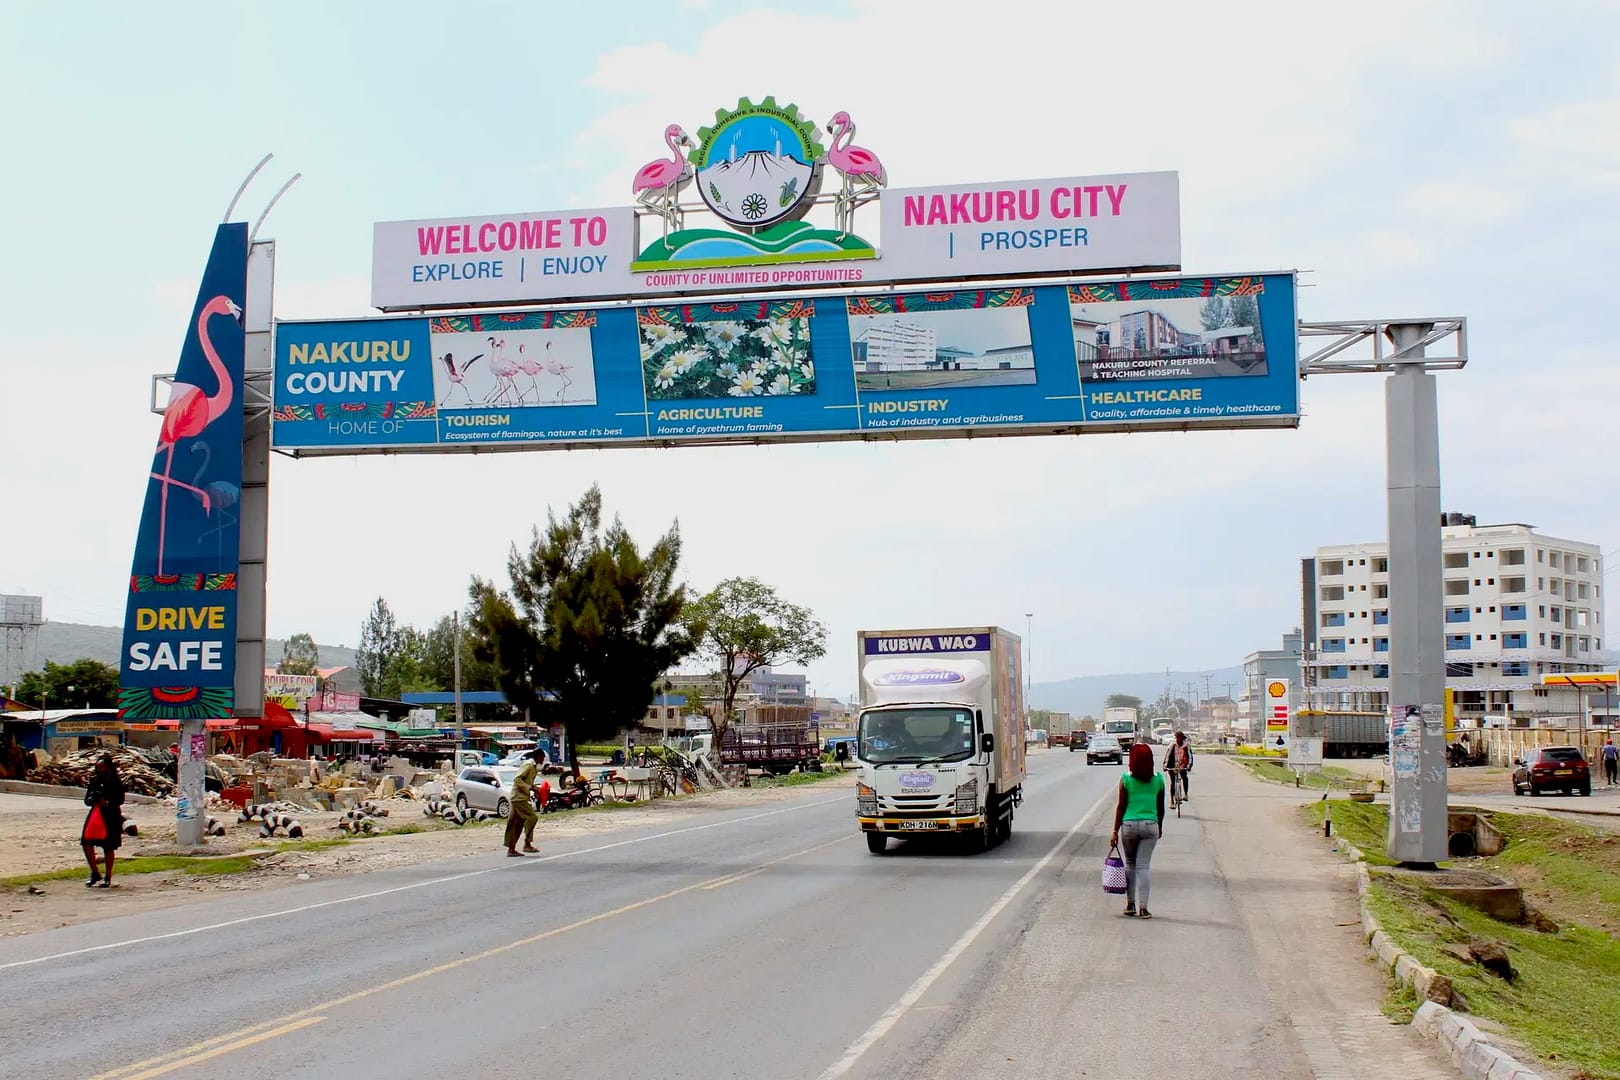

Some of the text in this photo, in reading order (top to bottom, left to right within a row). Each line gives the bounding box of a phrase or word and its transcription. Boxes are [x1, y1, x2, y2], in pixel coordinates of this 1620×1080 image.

[698, 136, 712, 166] SECURE
[711, 110, 748, 135] COHESIVE
[757, 107, 799, 129] INDUSTRIAL
[799, 128, 815, 159] COUNTY
[904, 184, 1128, 227] NAKURU CITY
[417, 216, 607, 256] WELCOME TO
[980, 227, 1089, 252] PROSPER
[412, 255, 608, 283] EXPLORE ENJOY
[646, 269, 863, 287] COUNTY OF UNLIMITED OPPORTUNITIES
[288, 339, 411, 365] NAKURU
[1092, 357, 1217, 370] NAKURU COUNTY REFERRAL
[1100, 369, 1147, 379] TEACHING
[1147, 368, 1193, 377] HOSPITAL
[286, 370, 406, 395] COUNTY
[1091, 388, 1202, 405] HEALTHCARE
[657, 406, 763, 421] AGRICULTURE
[868, 399, 949, 414] INDUSTRY
[1090, 403, 1281, 419] Quality, affordable & timely healthcare
[328, 420, 404, 435] HOME OF
[445, 414, 511, 428] TOURISM
[657, 422, 783, 435] Home of pyrethrum farming
[868, 413, 1024, 427] Hub of industry and agribusiness
[445, 426, 624, 441] Ecosystem of flamingos, nature at it's best
[136, 606, 225, 631] DRIVE
[878, 635, 977, 652] KUBWA WAO
[129, 640, 223, 672] SAFE
